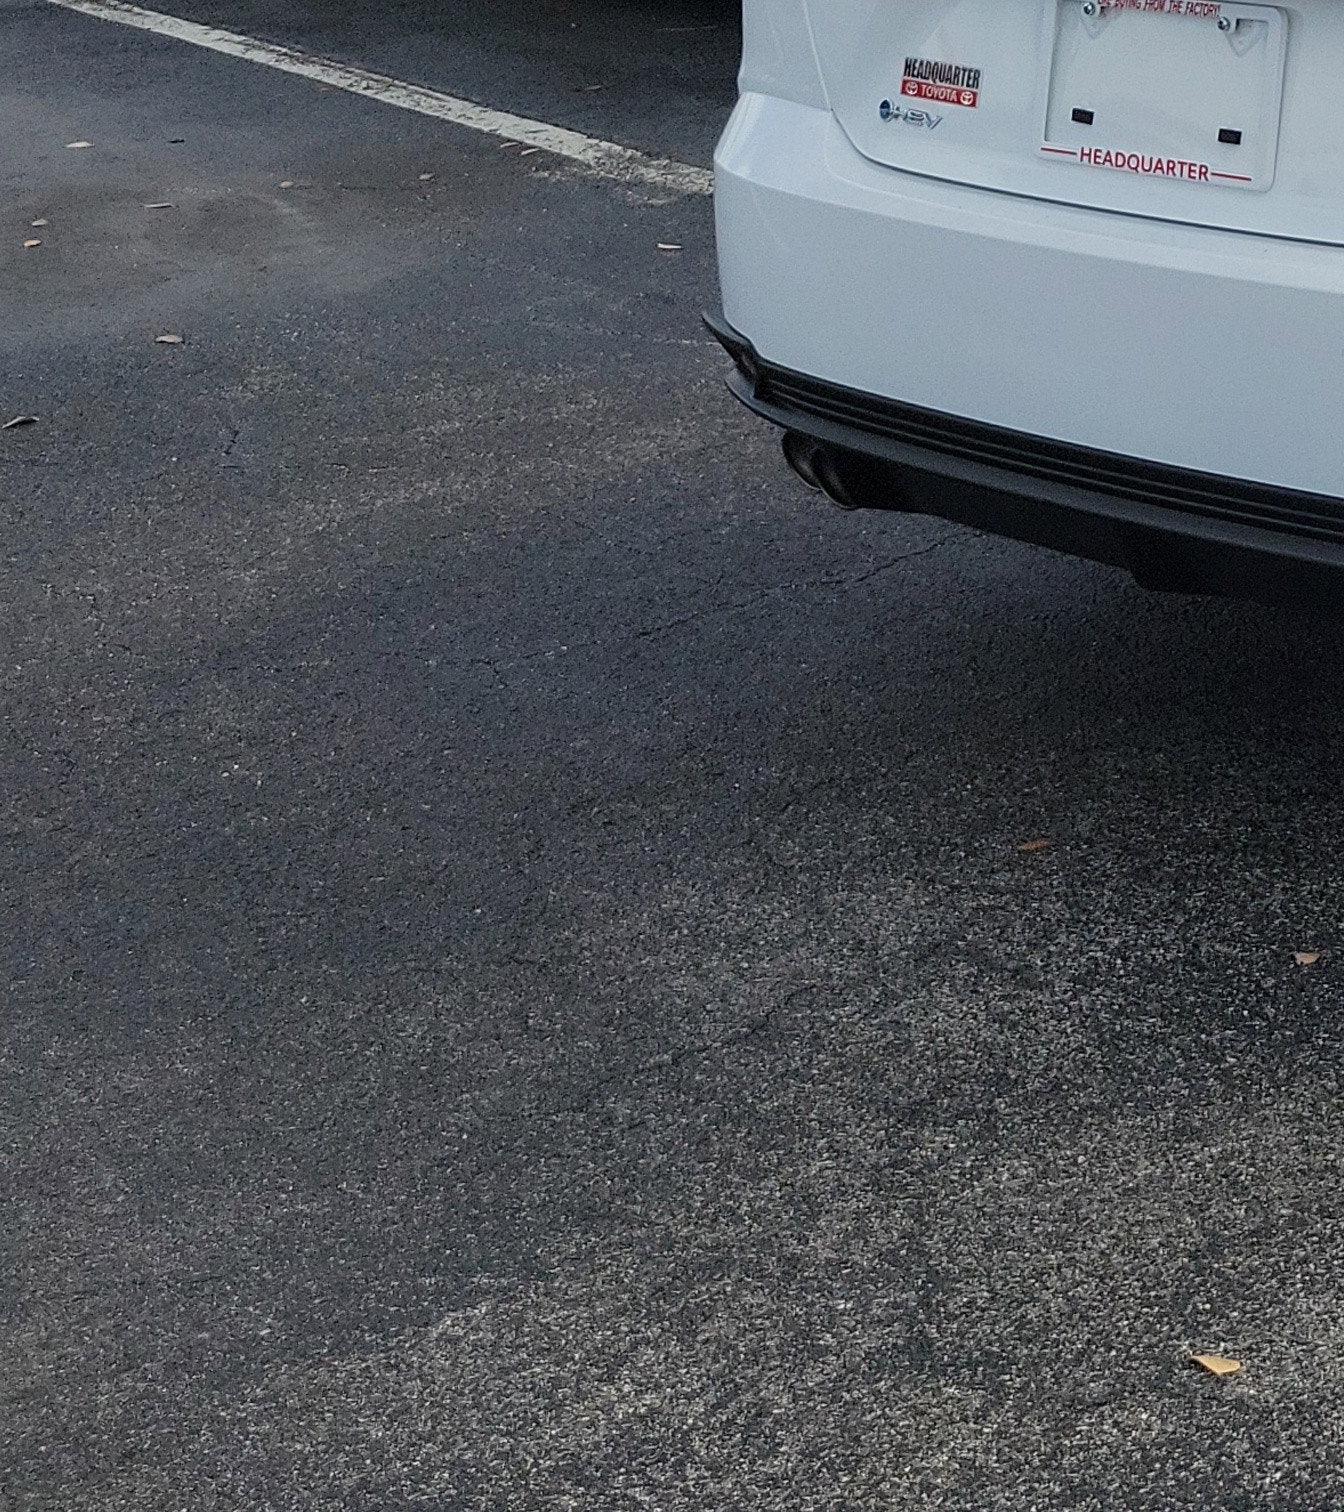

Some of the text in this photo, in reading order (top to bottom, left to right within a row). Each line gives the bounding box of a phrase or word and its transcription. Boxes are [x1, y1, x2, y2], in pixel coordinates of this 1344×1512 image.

[1168, 0, 1183, 14] THE
[1184, 1, 1222, 17] FACTORY!
[902, 57, 978, 90] HEADQUARTER
[920, 84, 955, 102] TOYOTA
[1079, 146, 1210, 182] HEADQUARTER
